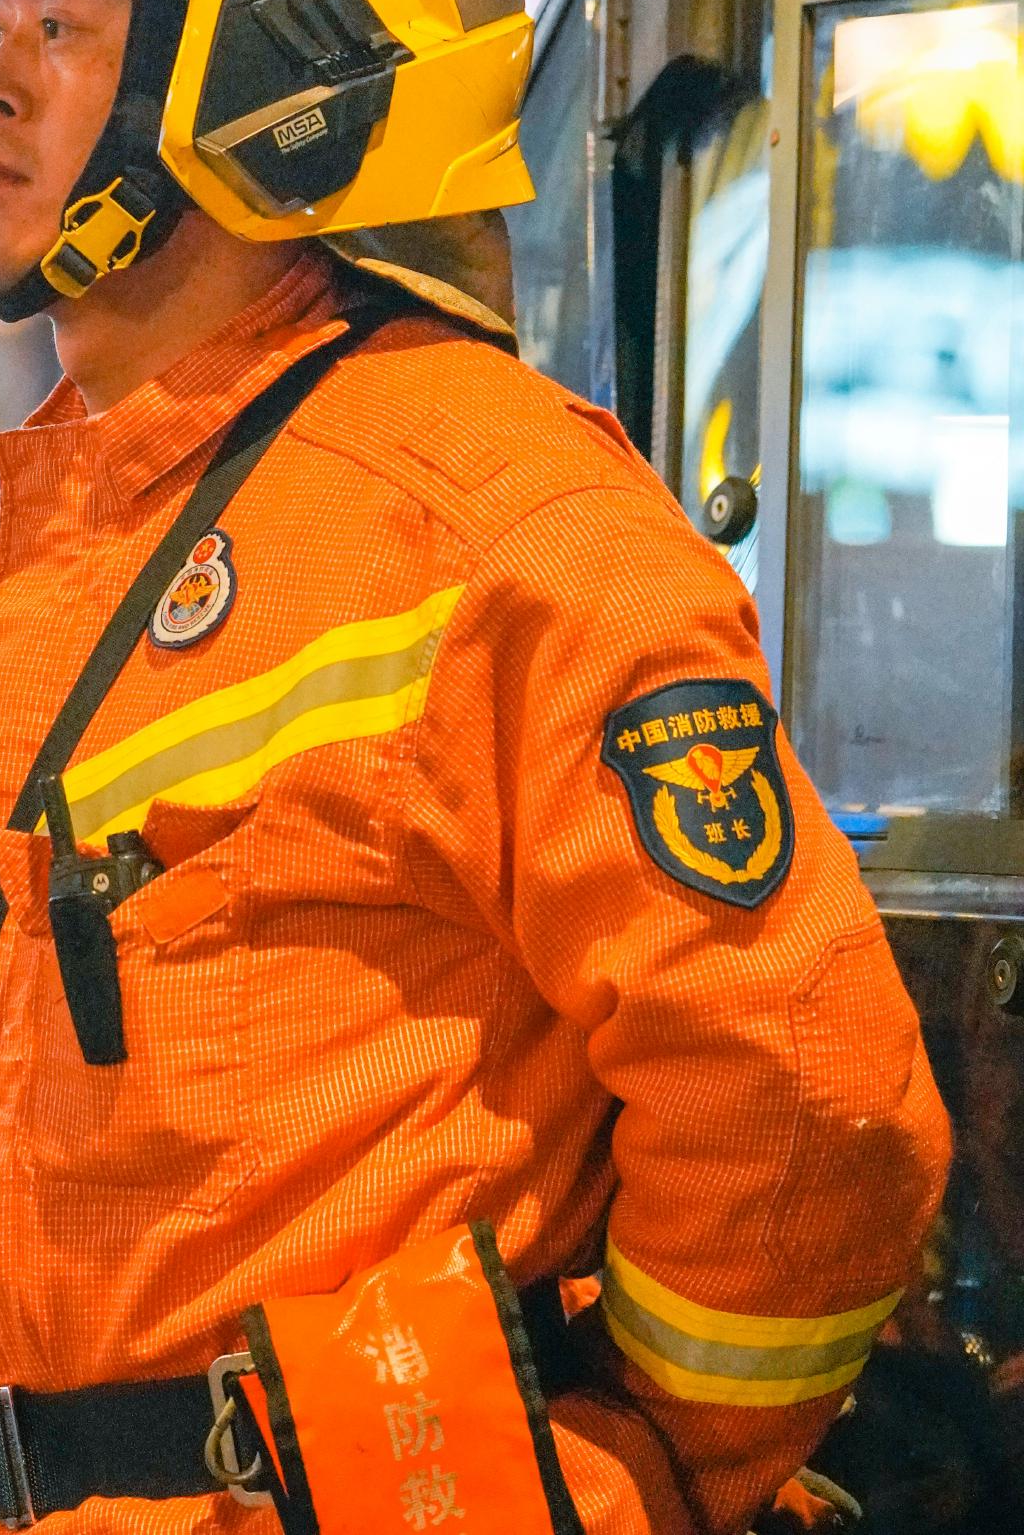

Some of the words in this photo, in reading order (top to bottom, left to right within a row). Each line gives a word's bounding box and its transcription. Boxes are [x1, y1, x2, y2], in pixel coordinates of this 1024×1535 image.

[277, 113, 323, 145] MSA
[617, 702, 763, 753] 中国消防救援
[704, 818, 752, 844] 班长
